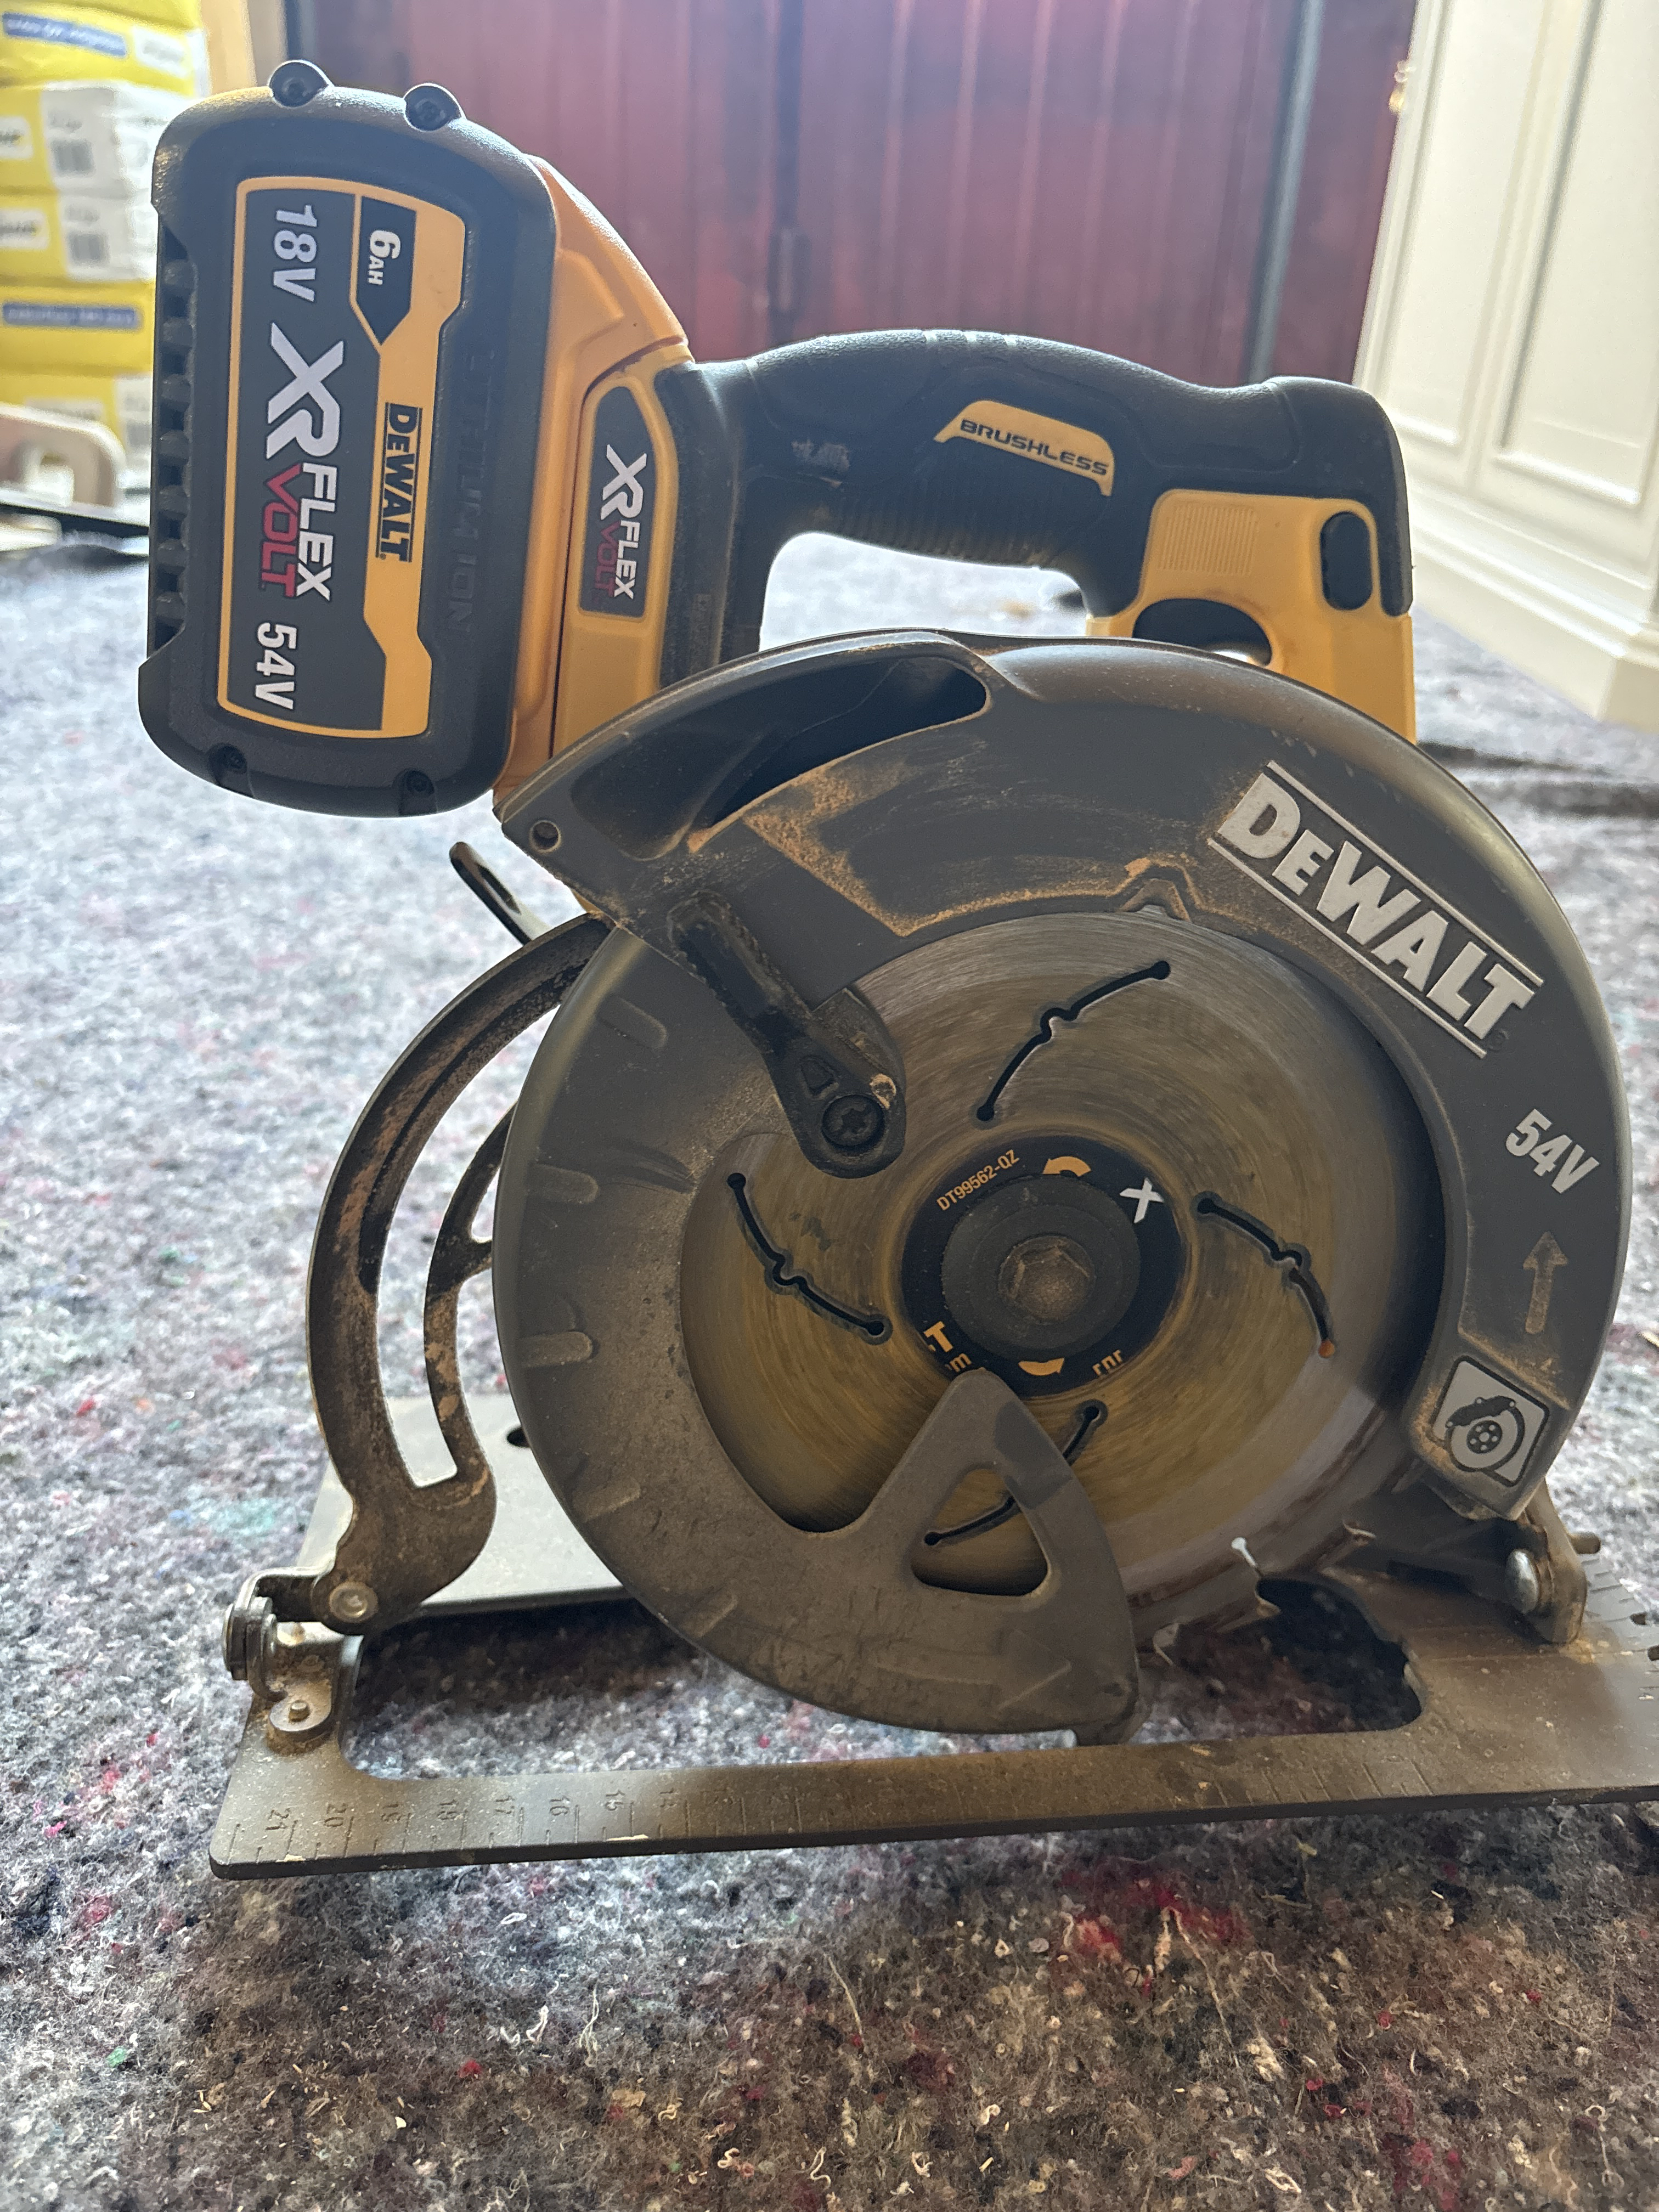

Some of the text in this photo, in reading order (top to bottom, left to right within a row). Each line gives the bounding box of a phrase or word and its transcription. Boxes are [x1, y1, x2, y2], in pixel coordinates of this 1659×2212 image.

[367, 229, 401, 286] 6AH
[255, 204, 345, 710] 18V XR FLEX 54V
[380, 402, 419, 562] DEWALT
[960, 418, 1109, 477] BRUSHLESS
[262, 462, 301, 597] VOLT
[594, 521, 621, 598] VOLT
[600, 444, 647, 600] XR FLEX
[1217, 772, 1535, 1040] DEWALT
[936, 1149, 1020, 1211] DT99562-QZ
[1505, 1108, 1600, 1195] 54V
